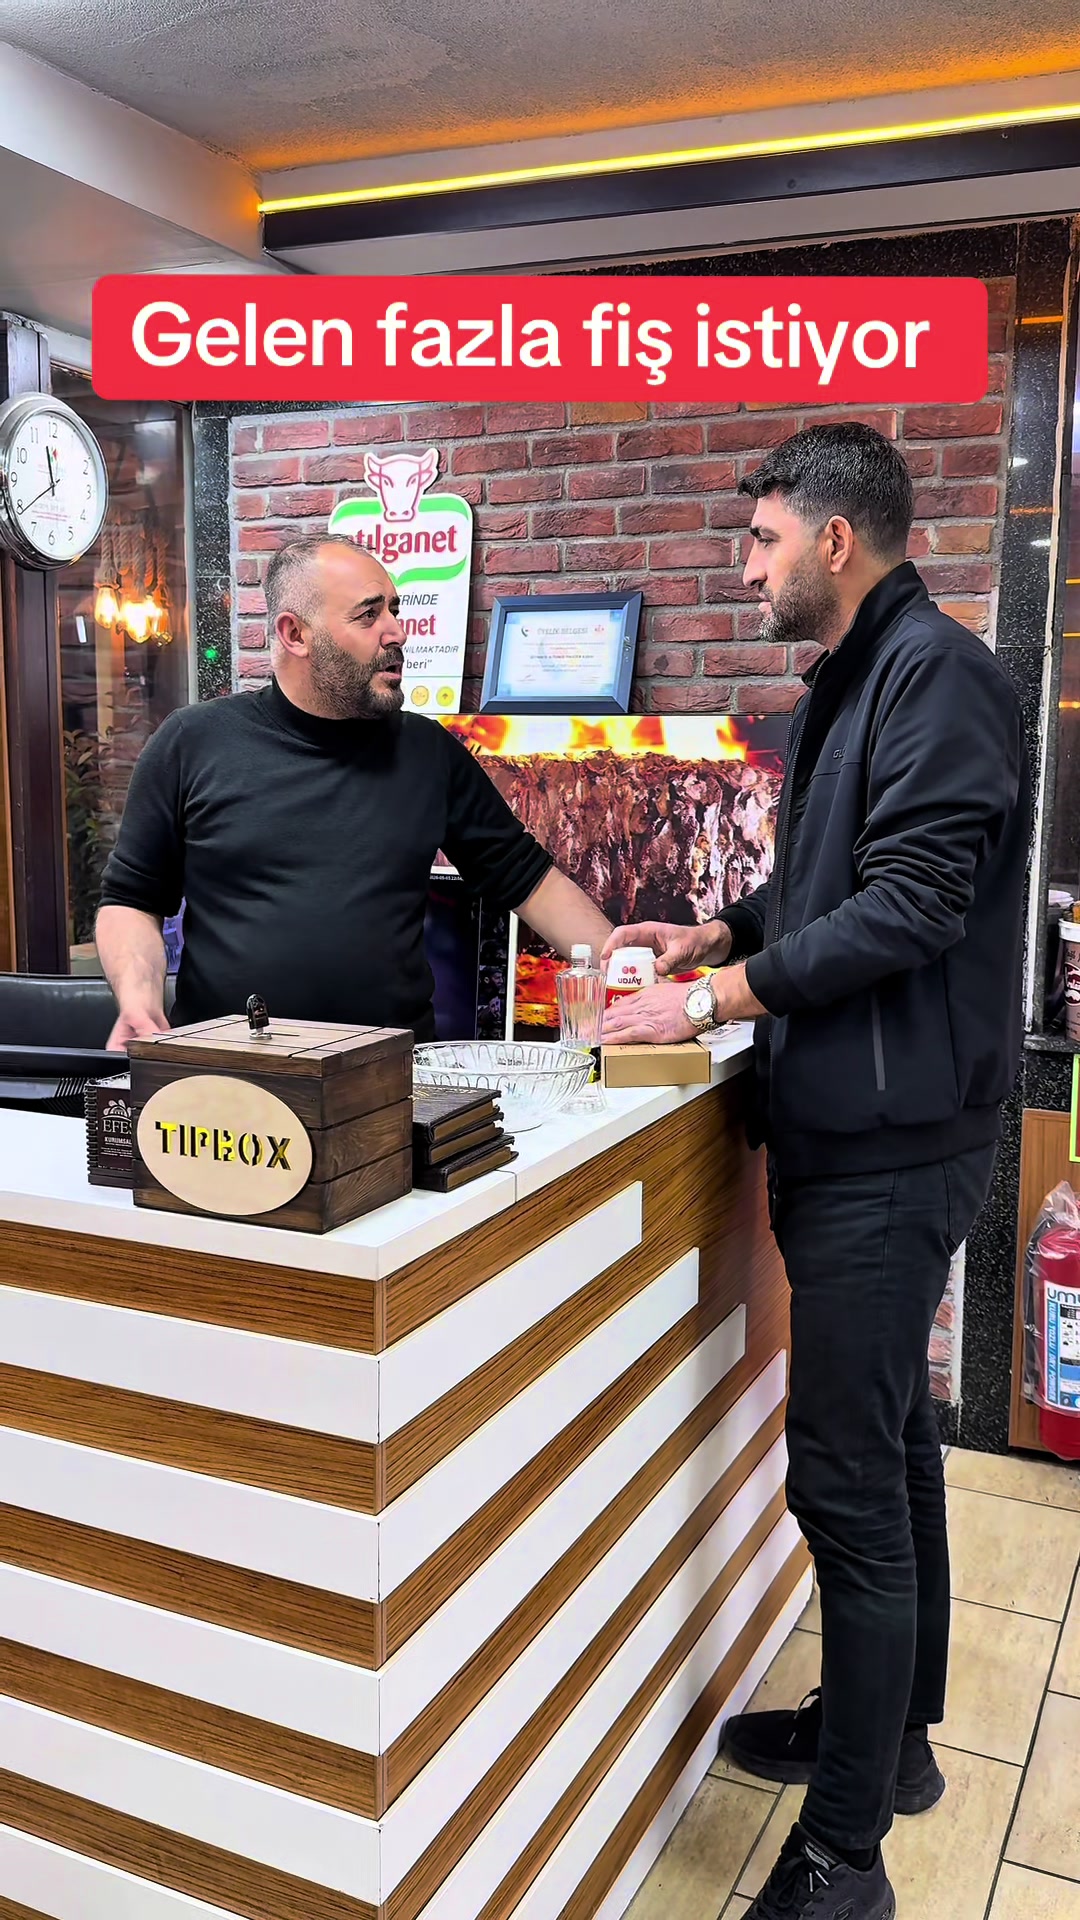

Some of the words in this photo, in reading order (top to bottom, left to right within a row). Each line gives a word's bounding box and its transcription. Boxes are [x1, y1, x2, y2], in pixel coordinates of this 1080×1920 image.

[30, 426, 39, 444] 11
[48, 421, 58, 439] 12
[16, 446, 28, 464] 10
[83, 460, 89, 476] 2
[10, 471, 18, 488] 9
[86, 484, 92, 500] 3
[16, 498, 24, 515] 8
[79, 508, 86, 521] 4
[30, 521, 38, 537] 7
[48, 529, 56, 546] 6
[67, 526, 74, 542] 5
[403, 645, 459, 654] NILMAKTADIR
[617, 976, 642, 986] Ayran
[155, 1121, 292, 1171] TIPBOX
[1047, 1287, 1080, 1304] um
